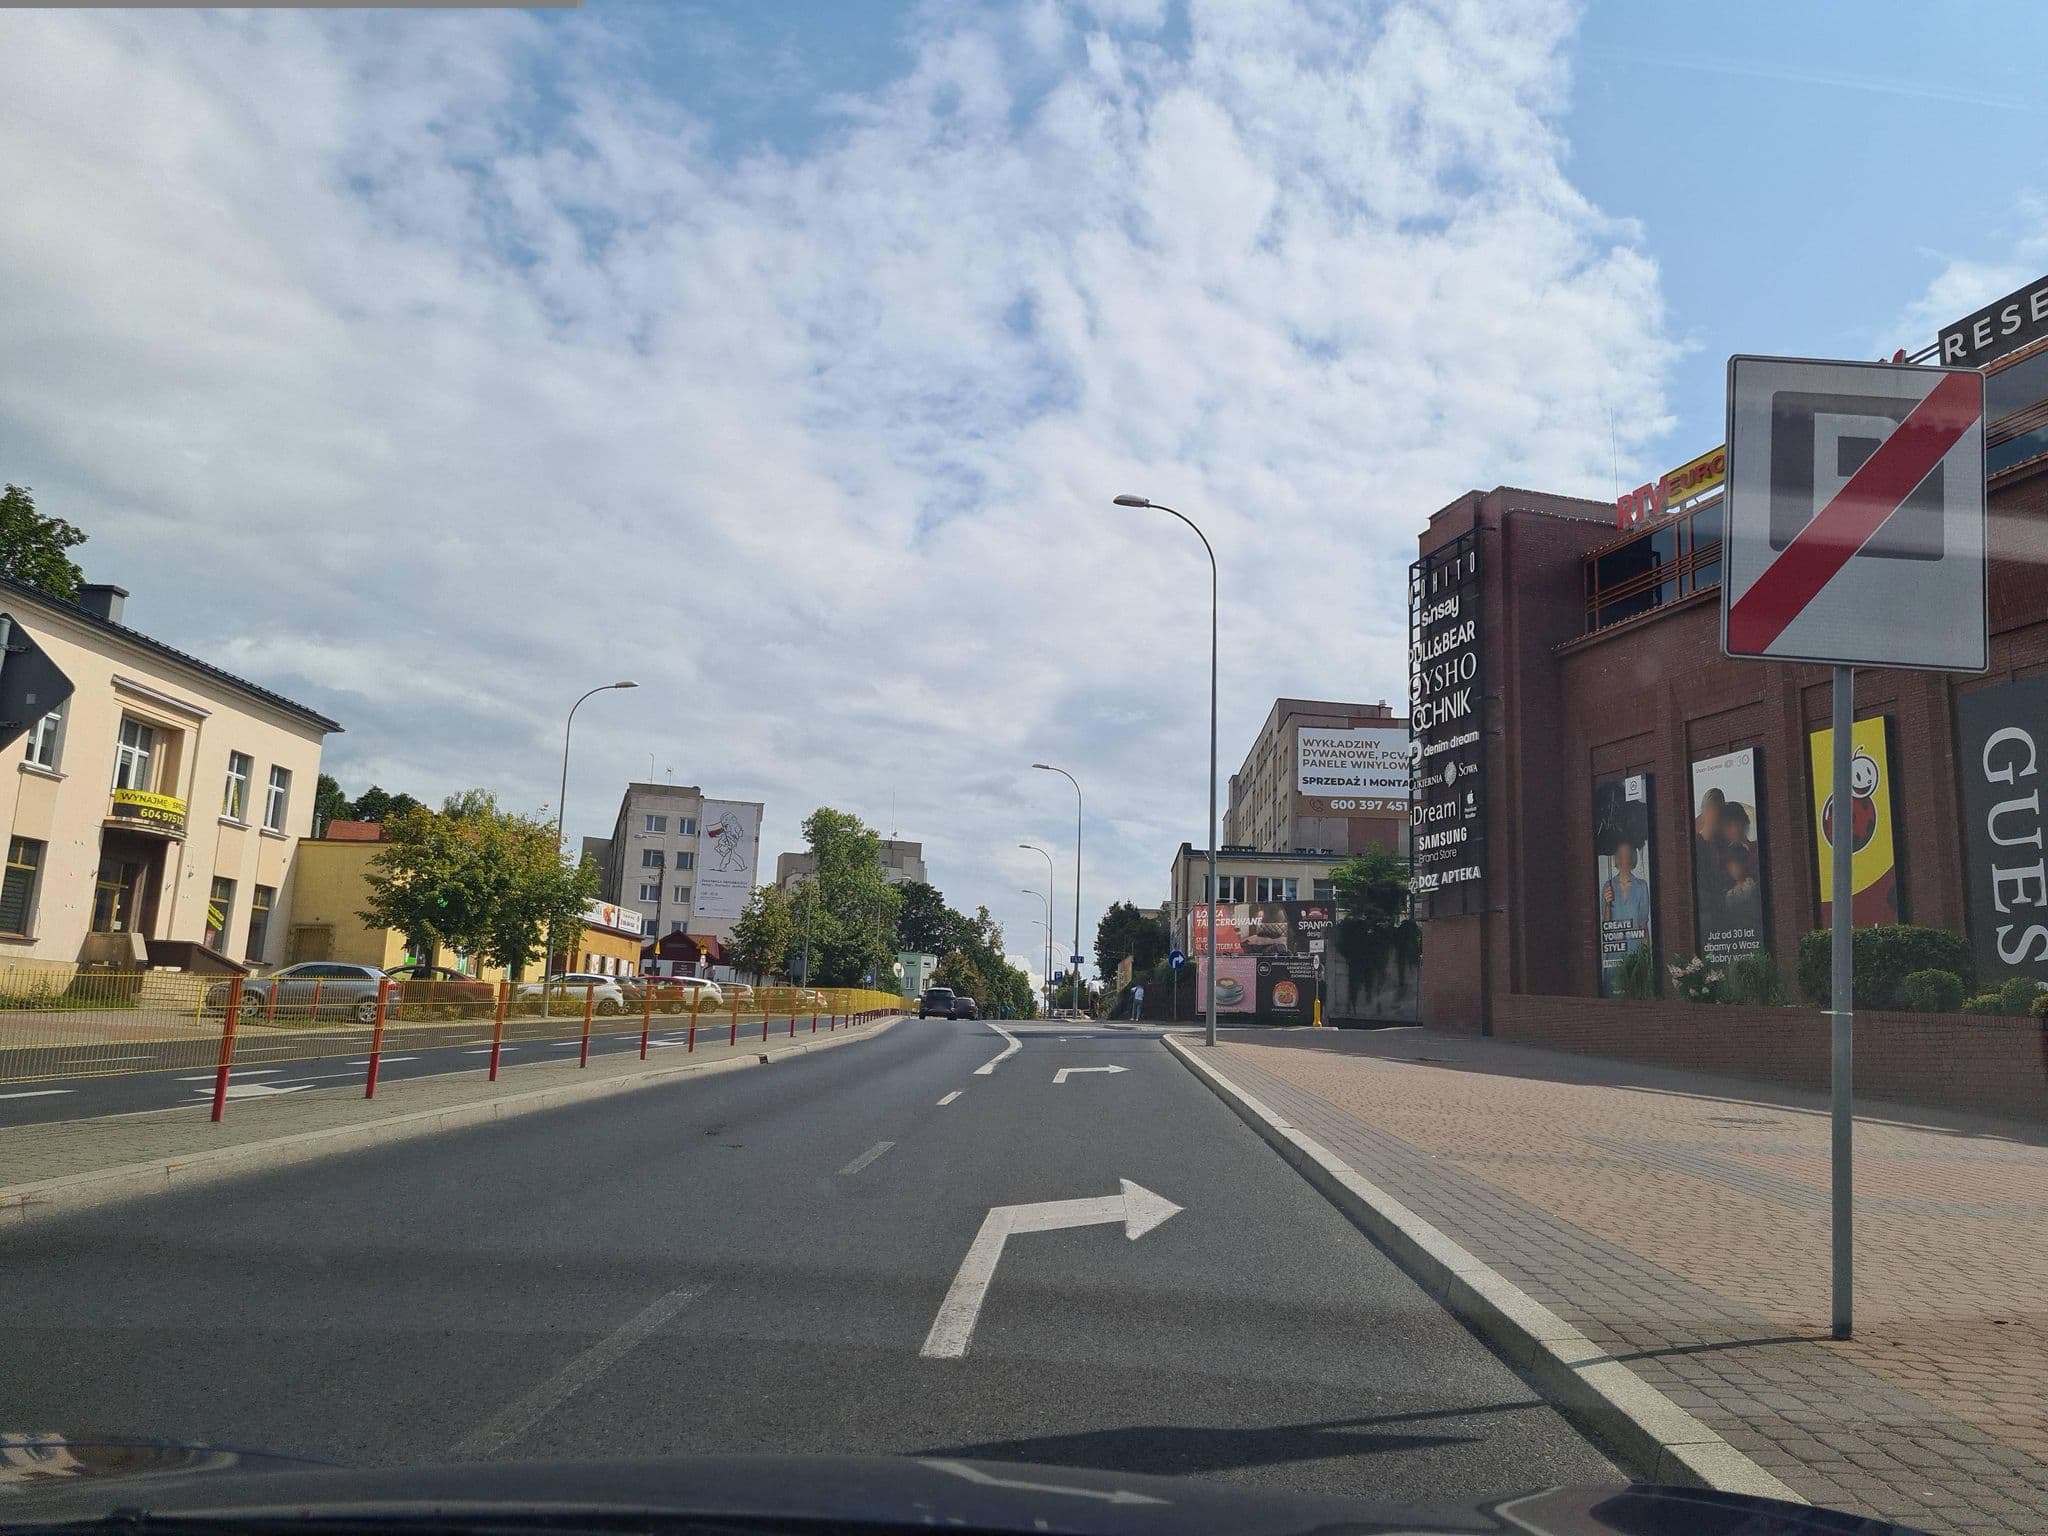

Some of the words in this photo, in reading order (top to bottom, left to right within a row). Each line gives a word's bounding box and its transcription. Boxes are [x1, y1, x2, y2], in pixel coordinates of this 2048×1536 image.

[1944, 287, 2048, 363] RESE
[1616, 476, 1667, 532] RTV
[1667, 454, 1725, 497] EURO
[1421, 595, 1459, 627] sinsay
[1408, 620, 1476, 664] PULL&BEAR
[1408, 652, 1477, 702] OYSHO
[1412, 687, 1471, 732] OCHNIK
[1302, 738, 1381, 749] WYKŁADZINY
[1424, 740, 1448, 757] denim
[1450, 731, 1479, 748] dream
[1303, 749, 1378, 760] DYWANOWE,
[1303, 759, 1347, 768] PANELE
[1302, 776, 1361, 786] SPRZEDAŻ
[1363, 778, 1366, 786] I
[1330, 800, 1355, 810] 600
[1360, 800, 1383, 810] 397
[1386, 801, 1408, 811] 451
[141, 808, 161, 819] 604
[1409, 801, 1456, 827] iDream
[1419, 827, 1467, 851] SAMSUNG
[1419, 852, 1439, 864] Brand
[1440, 848, 1457, 860] Store
[1419, 874, 1439, 888] DOZ
[1441, 866, 1481, 884] APTEKA
[1298, 920, 1333, 930] SPANKO
[1603, 922, 1631, 930] CREATE
[1603, 931, 1624, 941] YOUR
[1626, 930, 1644, 940] OWN
[1721, 931, 1731, 939] od
[1733, 929, 1742, 938] 30
[1744, 929, 1754, 938] lat
[1604, 943, 1626, 952] STYLE
[1739, 941, 1759, 950] Wasz
